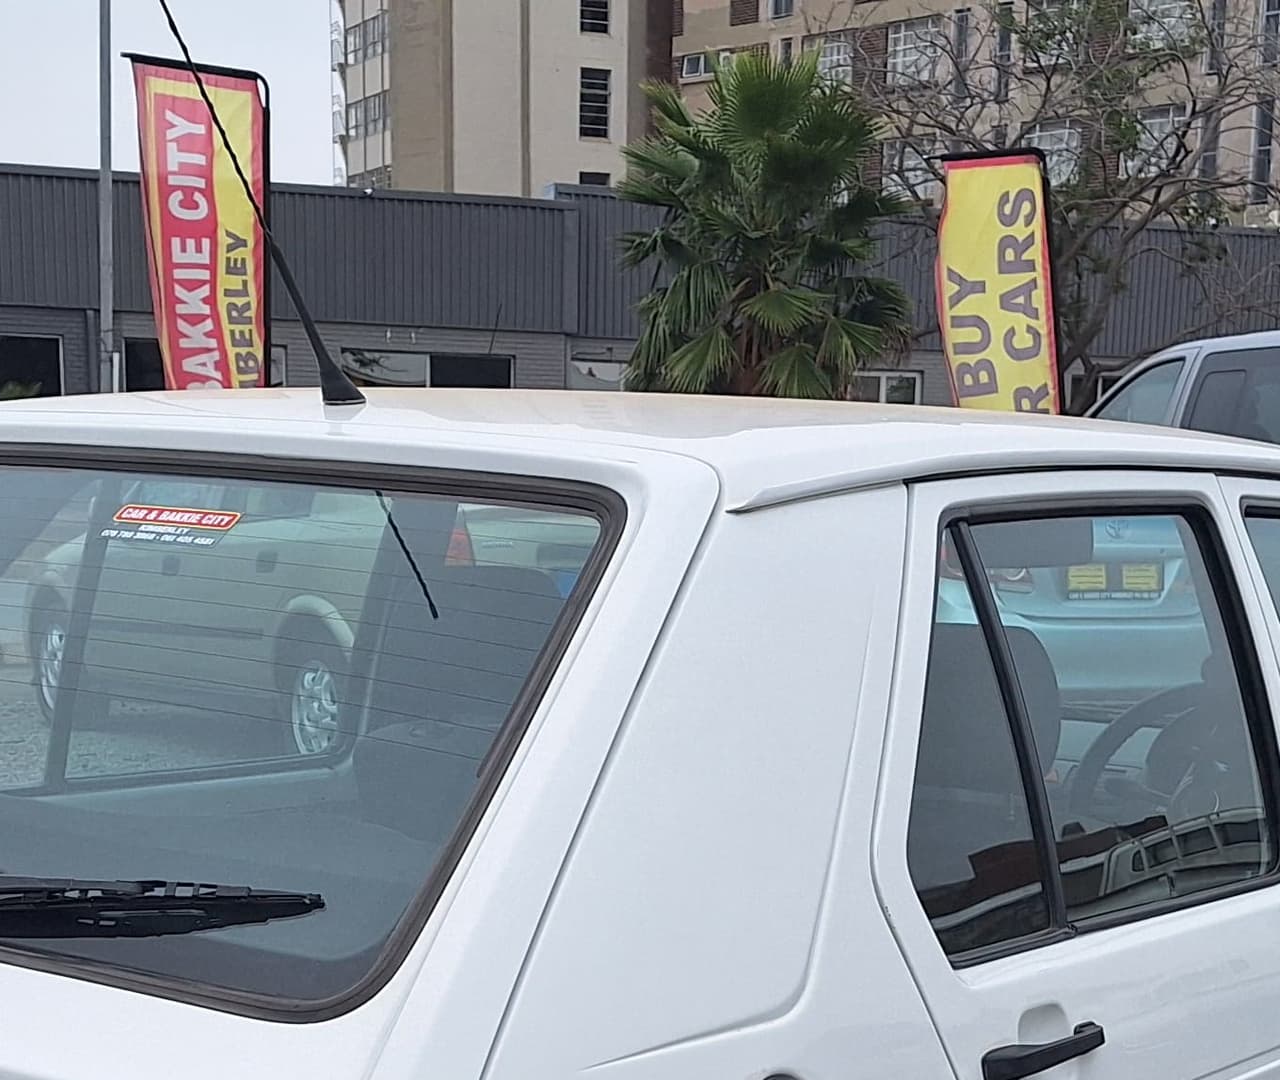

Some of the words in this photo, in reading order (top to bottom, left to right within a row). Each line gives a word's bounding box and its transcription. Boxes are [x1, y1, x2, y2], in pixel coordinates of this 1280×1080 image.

[164, 109, 208, 221] CITY
[223, 229, 258, 389] BERLEY
[946, 264, 999, 399] BUY
[996, 187, 1043, 362] CARS
